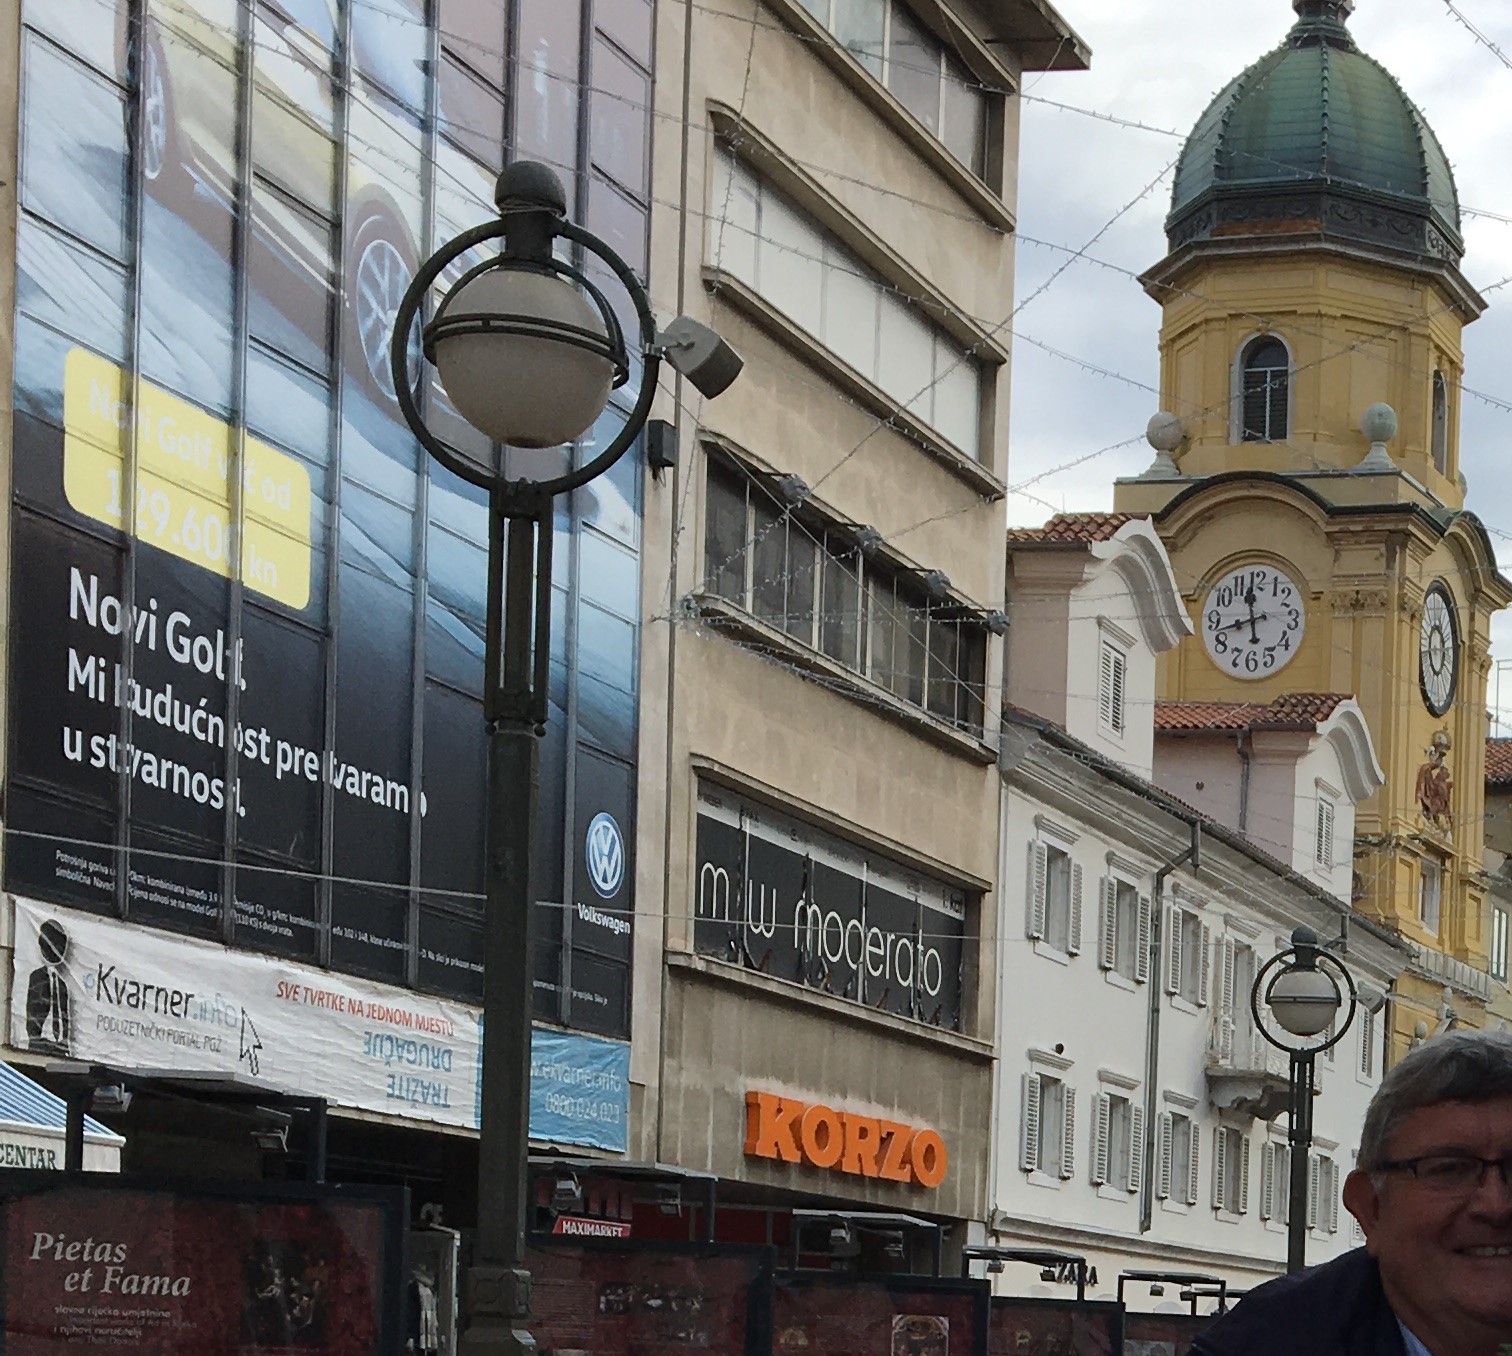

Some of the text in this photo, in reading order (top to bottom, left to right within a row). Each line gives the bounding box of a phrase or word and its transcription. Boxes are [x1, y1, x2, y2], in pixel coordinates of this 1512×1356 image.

[157, 416, 212, 470] Golf
[216, 456, 257, 495] vć
[261, 475, 292, 511] od
[249, 543, 278, 589] kn
[1233, 575, 1244, 596] 11
[1250, 571, 1266, 592] 12
[1272, 576, 1278, 597] 1
[1215, 586, 1232, 607] 10
[1281, 586, 1291, 608] 2
[69, 566, 157, 651] Novi
[1208, 609, 1221, 631] 9
[1287, 608, 1299, 630] 3
[1214, 632, 1228, 654] 8
[1277, 630, 1290, 651] 4
[1231, 646, 1243, 668] 7
[1245, 650, 1258, 672] 6
[1263, 645, 1276, 668] 5
[68, 647, 105, 702] Mi
[63, 726, 82, 762] u
[577, 902, 631, 935] Volkswagen
[794, 899, 942, 997] moderato
[276, 981, 454, 1037] SVE TVRTKE NA JEDNOM MJESTU
[744, 1090, 948, 1188] KORZO
[562, 1220, 623, 1238] MAXIMARKET
[29, 1231, 128, 1263] Pietas
[64, 1265, 191, 1297] et Fama
[1056, 1262, 1099, 1287] ZAA
